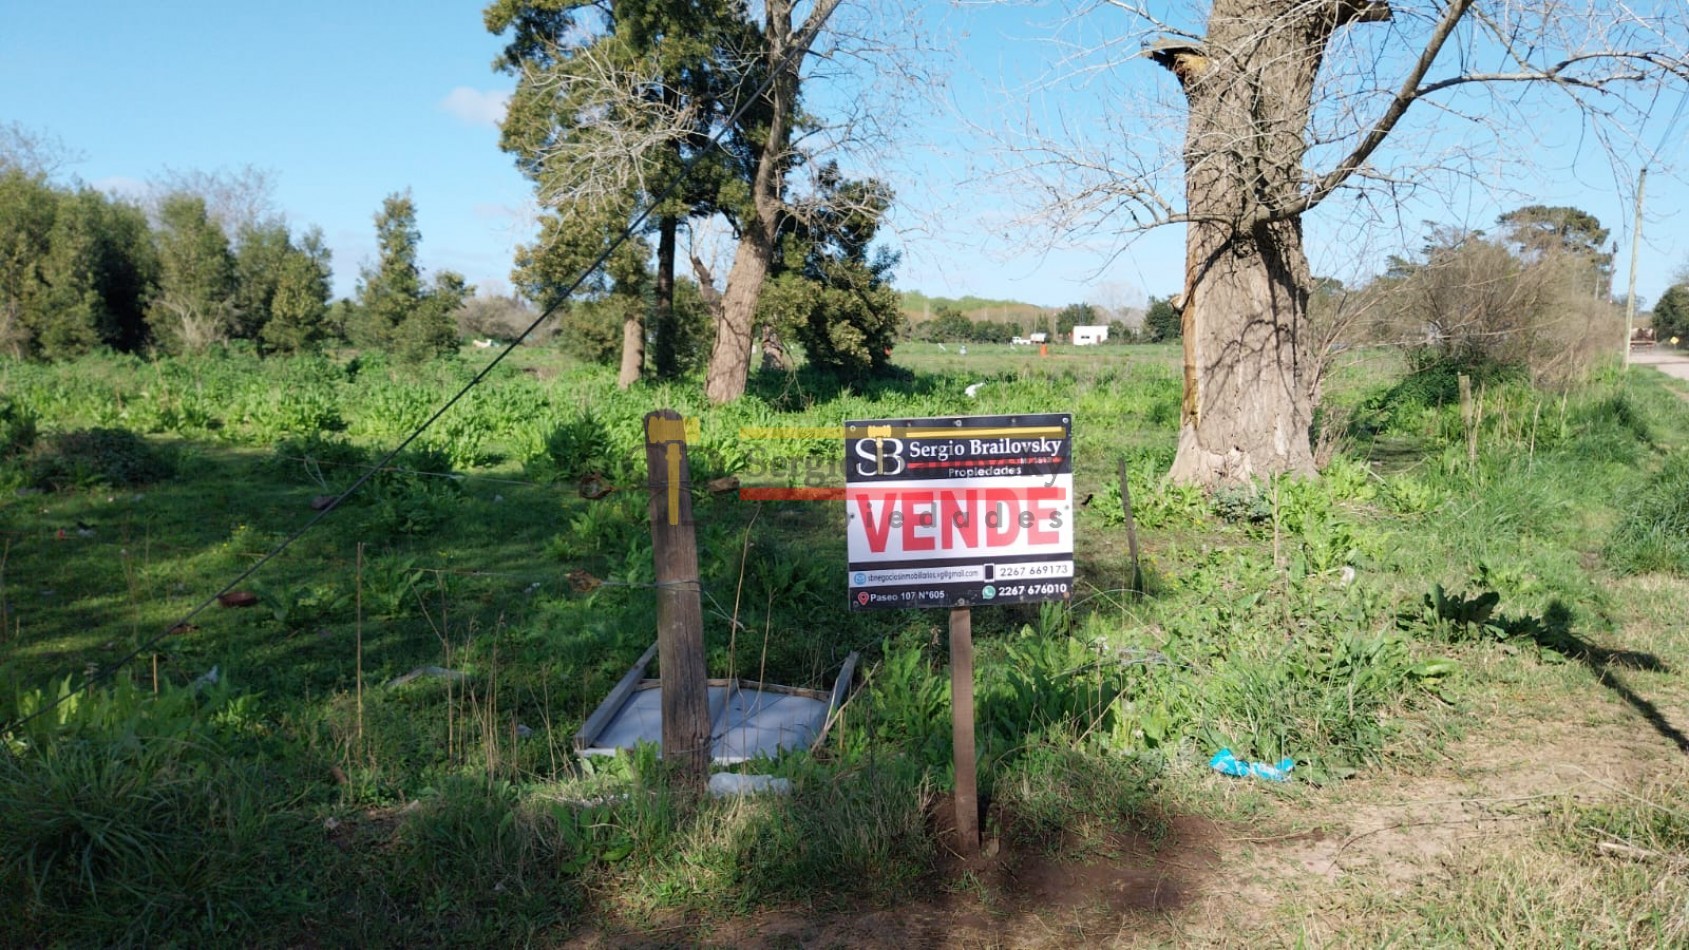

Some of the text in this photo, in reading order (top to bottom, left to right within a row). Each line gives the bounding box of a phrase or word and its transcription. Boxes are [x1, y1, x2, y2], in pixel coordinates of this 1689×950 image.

[909, 437, 1062, 461] Sergio Brailovsky
[949, 465, 1022, 479] Propiedades
[855, 487, 1059, 553] VENDE
[1000, 564, 1069, 577] 2267 669173
[870, 593, 898, 602] Paseo
[901, 591, 916, 600] 107
[998, 583, 1068, 597] 2267 676010
